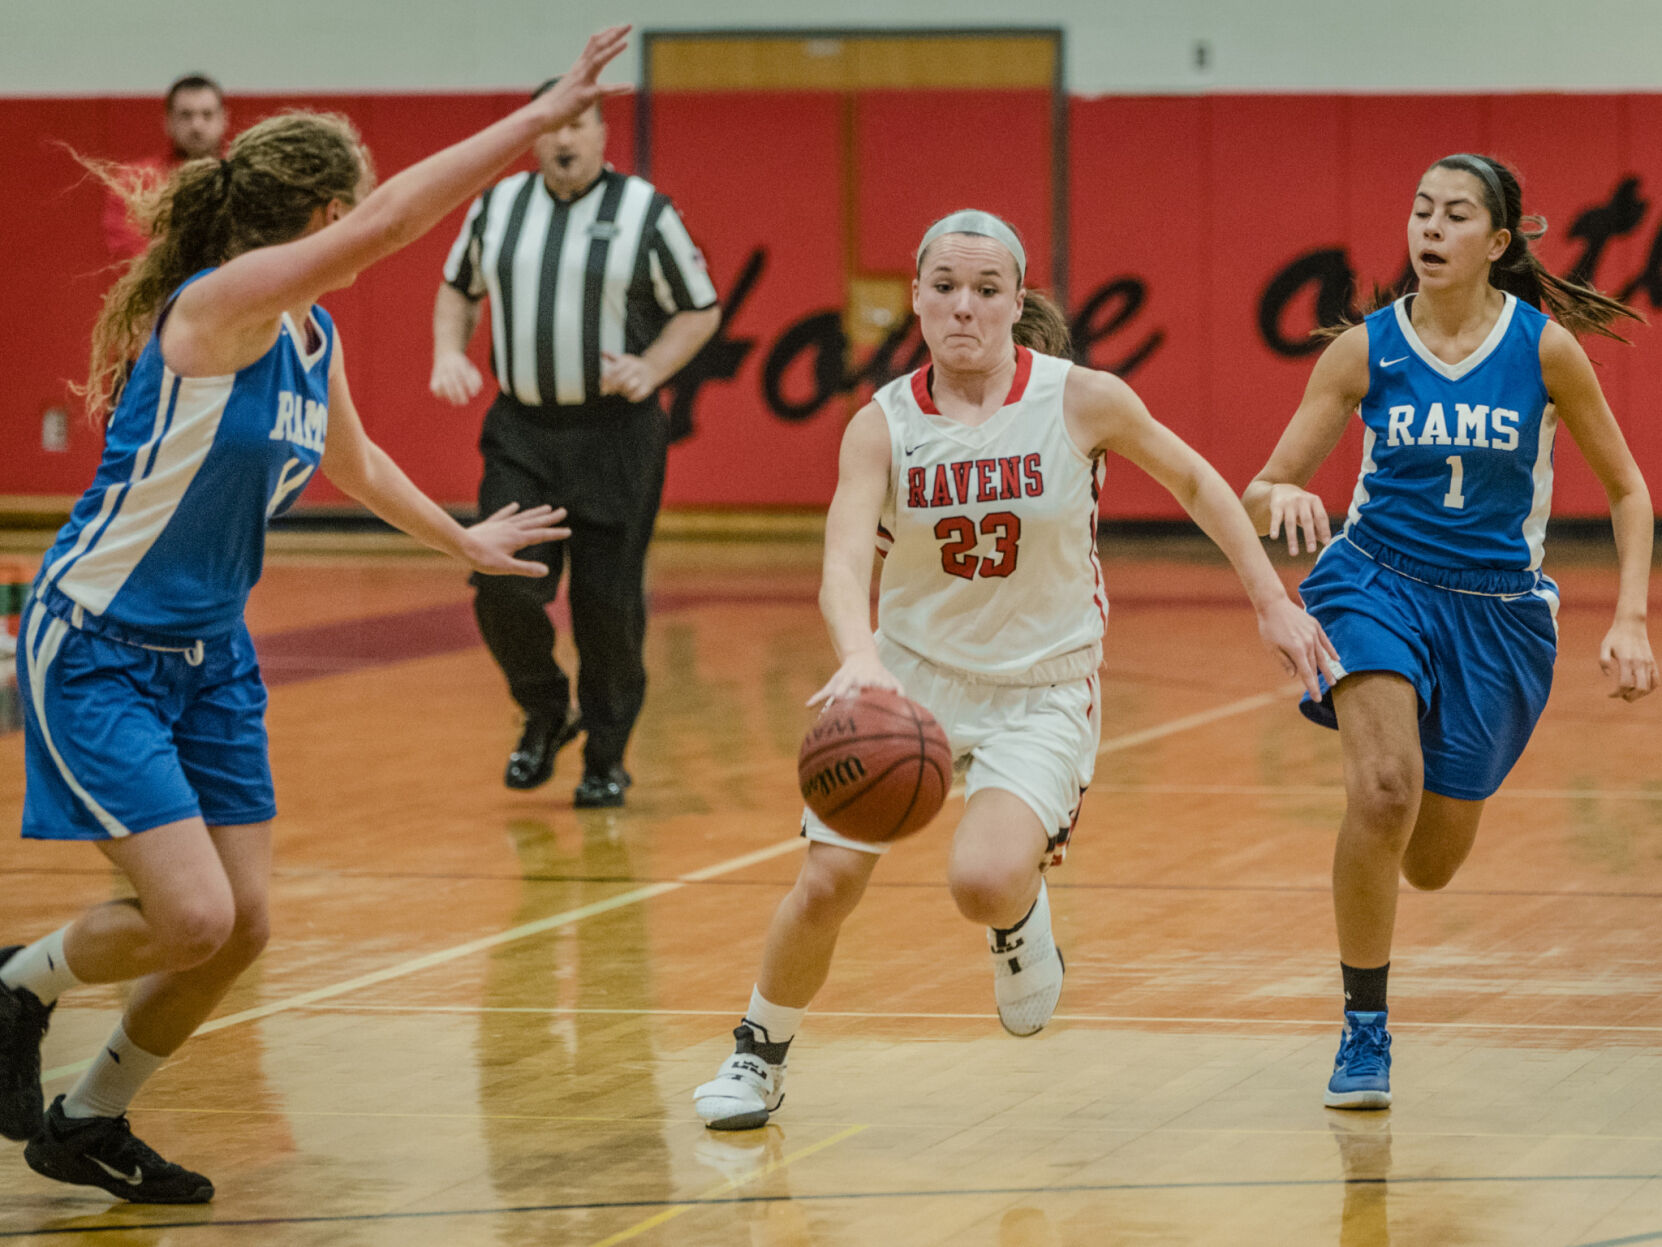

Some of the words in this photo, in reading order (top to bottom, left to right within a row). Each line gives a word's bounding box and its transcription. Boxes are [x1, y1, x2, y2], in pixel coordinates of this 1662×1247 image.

[666, 247, 1165, 445] Hoe
[269, 391, 328, 456] RAM
[1387, 402, 1519, 451] RAMS
[908, 453, 1044, 508] RAVENS
[1443, 455, 1465, 509] 1
[934, 511, 1021, 581] 23
